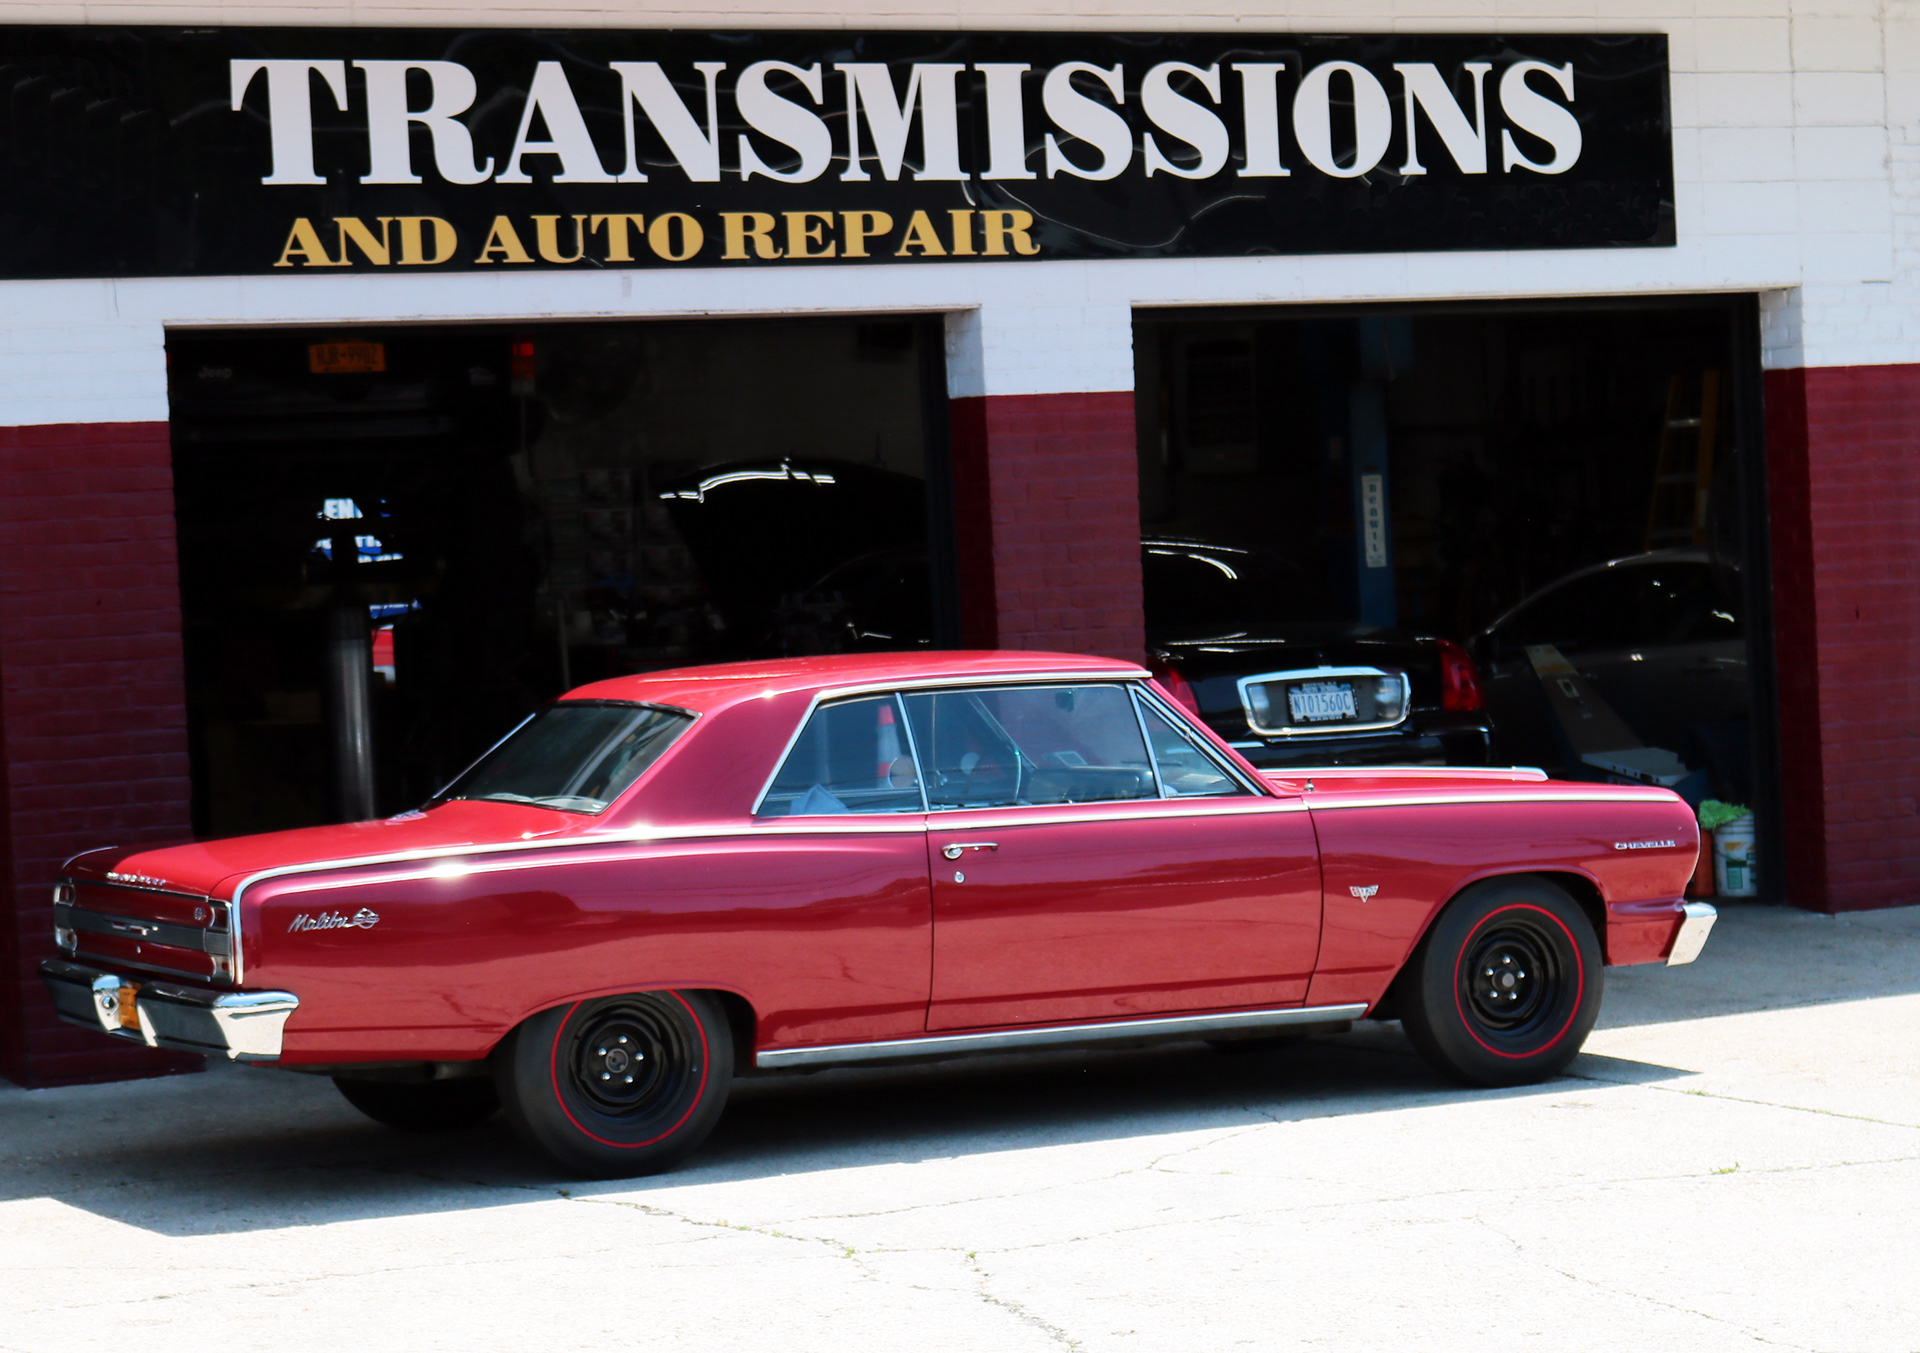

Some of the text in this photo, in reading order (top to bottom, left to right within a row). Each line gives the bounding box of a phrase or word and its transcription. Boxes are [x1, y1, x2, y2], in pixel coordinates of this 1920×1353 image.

[231, 60, 1581, 184] TRANSMISSIONS
[274, 210, 1040, 266] AND AUTO REPAIR
[1293, 693, 1351, 714] N101560C
[1614, 840, 1675, 850] CHEVELLE
[288, 910, 351, 932] Malibu
